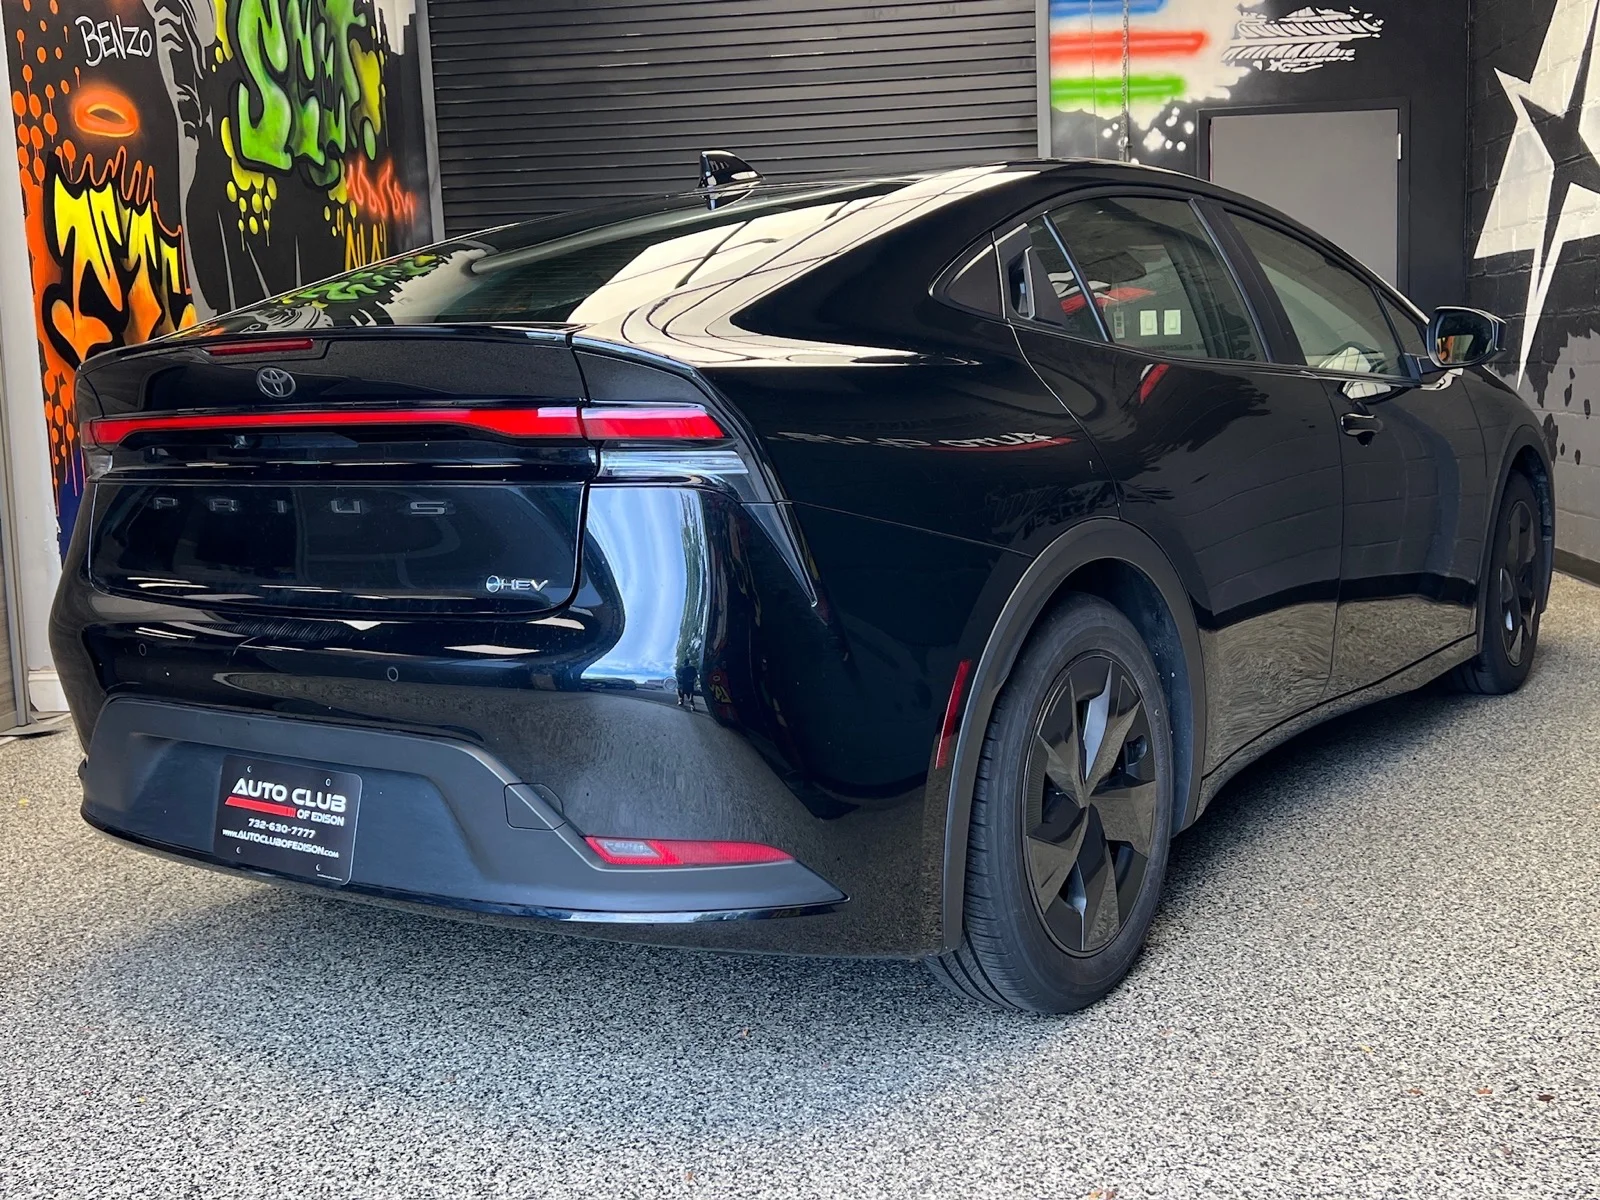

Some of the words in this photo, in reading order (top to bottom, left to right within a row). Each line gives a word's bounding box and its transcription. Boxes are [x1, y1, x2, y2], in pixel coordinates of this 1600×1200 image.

[75, 14, 153, 67] BENZO
[154, 497, 448, 515] PRIUS
[232, 777, 288, 802] AUTO
[291, 788, 347, 813] CLUB
[248, 818, 316, 839] 732-630-7777
[297, 809, 311, 820] OF
[311, 811, 345, 827] EDISON
